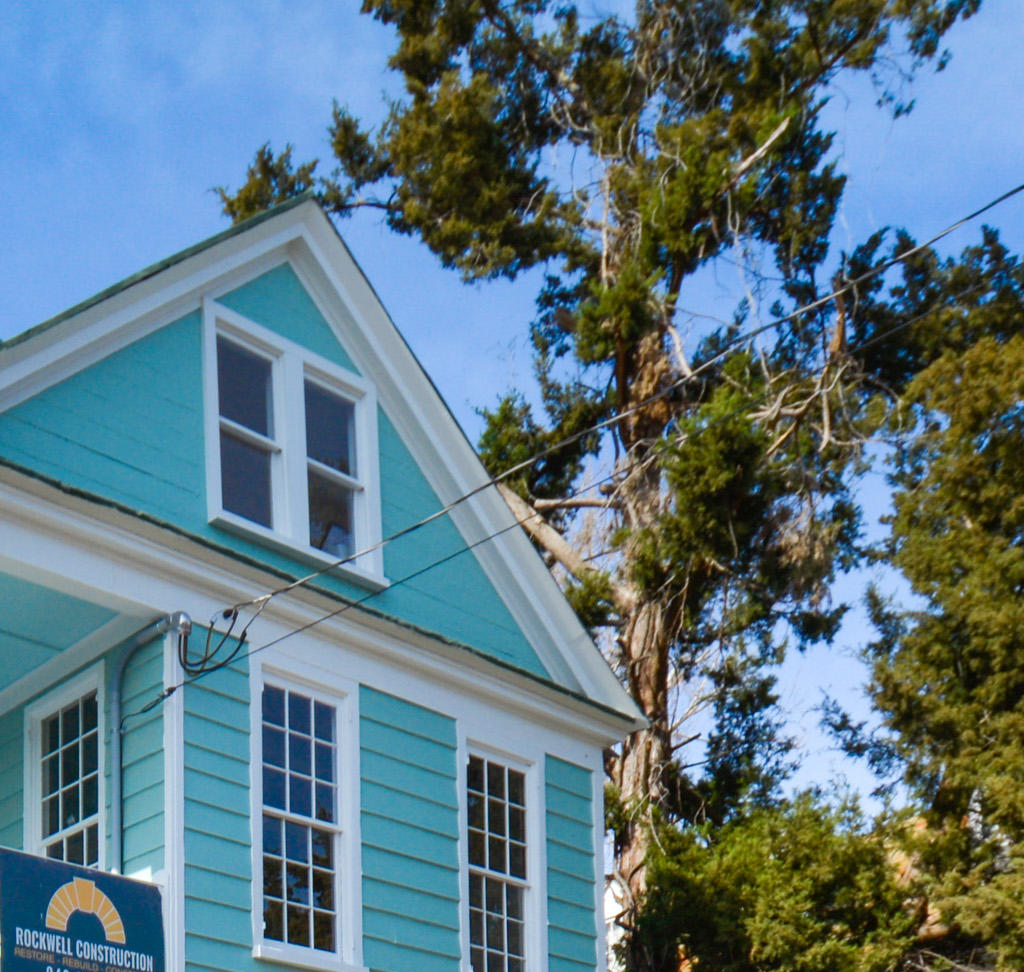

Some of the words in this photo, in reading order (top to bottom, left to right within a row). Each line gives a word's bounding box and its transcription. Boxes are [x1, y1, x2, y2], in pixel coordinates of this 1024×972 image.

[15, 926, 73, 956] ROCKWELL
[14, 947, 55, 964] RESTORE
[62, 956, 99, 972] REBUILD
